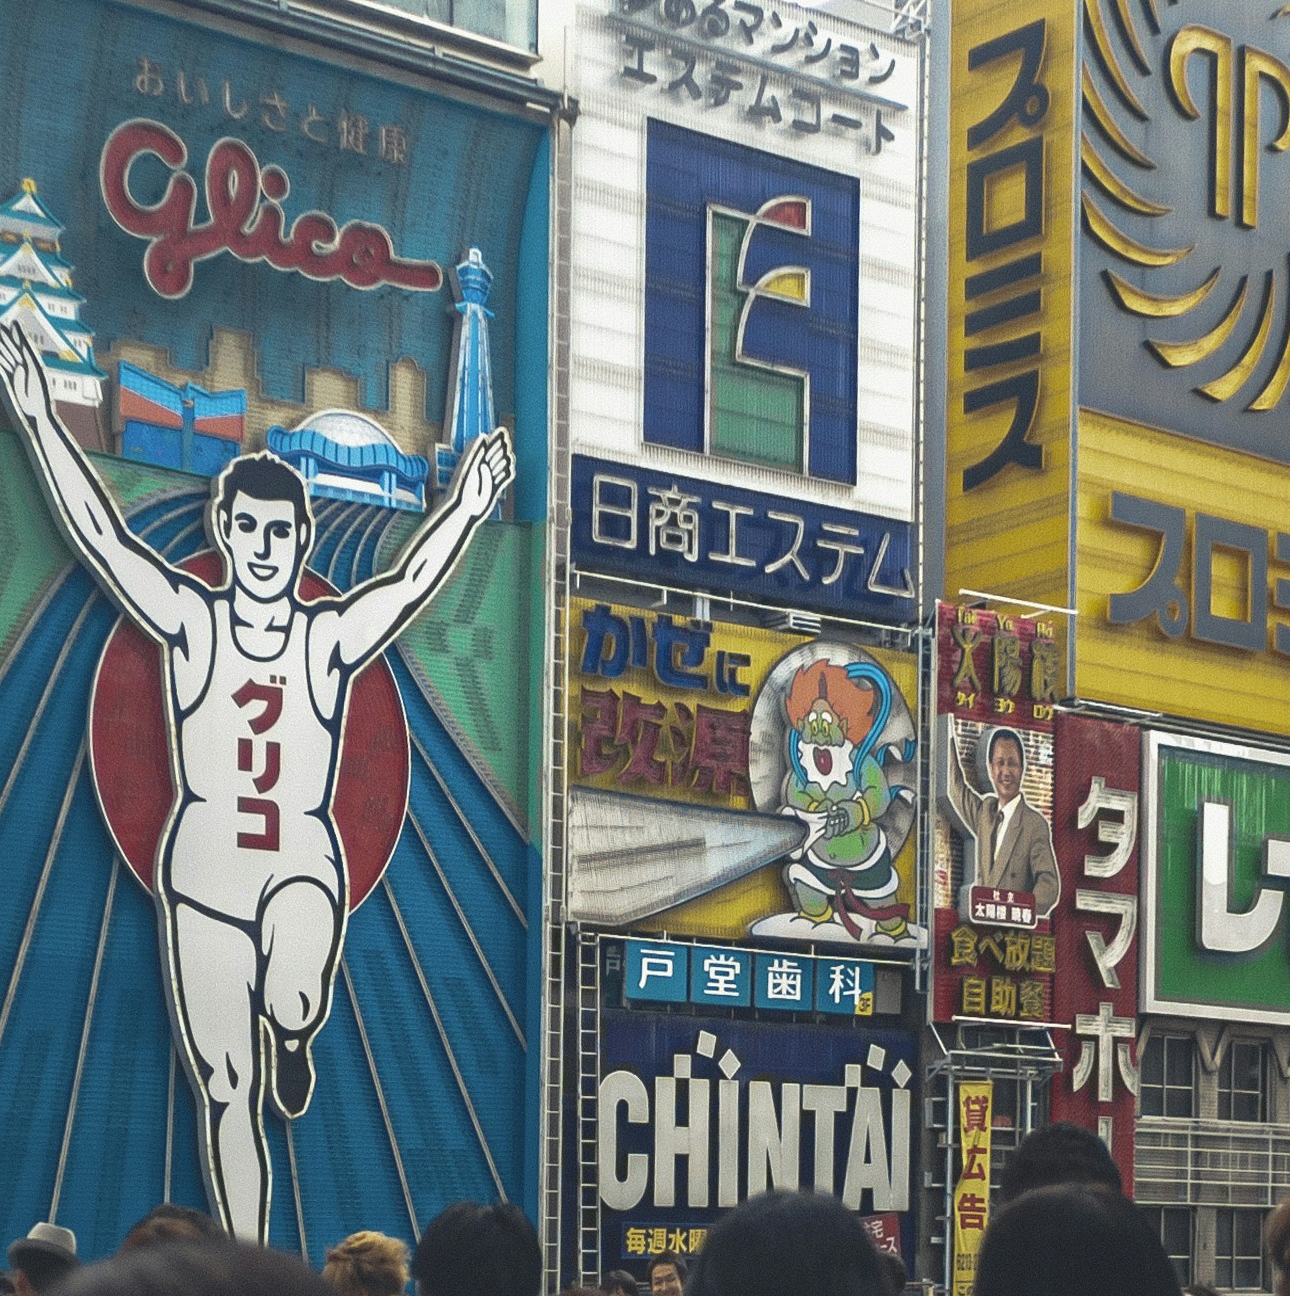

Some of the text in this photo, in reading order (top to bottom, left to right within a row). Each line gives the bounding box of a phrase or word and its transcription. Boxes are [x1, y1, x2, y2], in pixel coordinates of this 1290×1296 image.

[134, 55, 409, 165] おいしさと健康
[622, 33, 896, 156] エステムコート
[100, 118, 443, 299] Glico
[962, 17, 1051, 492] プロミス
[592, 473, 916, 599] 日商エステム
[580, 604, 753, 698] かぜに
[230, 674, 287, 852] グリコ
[579, 685, 752, 800] 改源
[638, 948, 861, 1005] 戸堂歯科
[950, 924, 1056, 974] 食べ放題
[962, 975, 1046, 1019] 自助餐
[598, 1052, 912, 1212] CHINTAI
[957, 1094, 990, 1231] 貸広告
